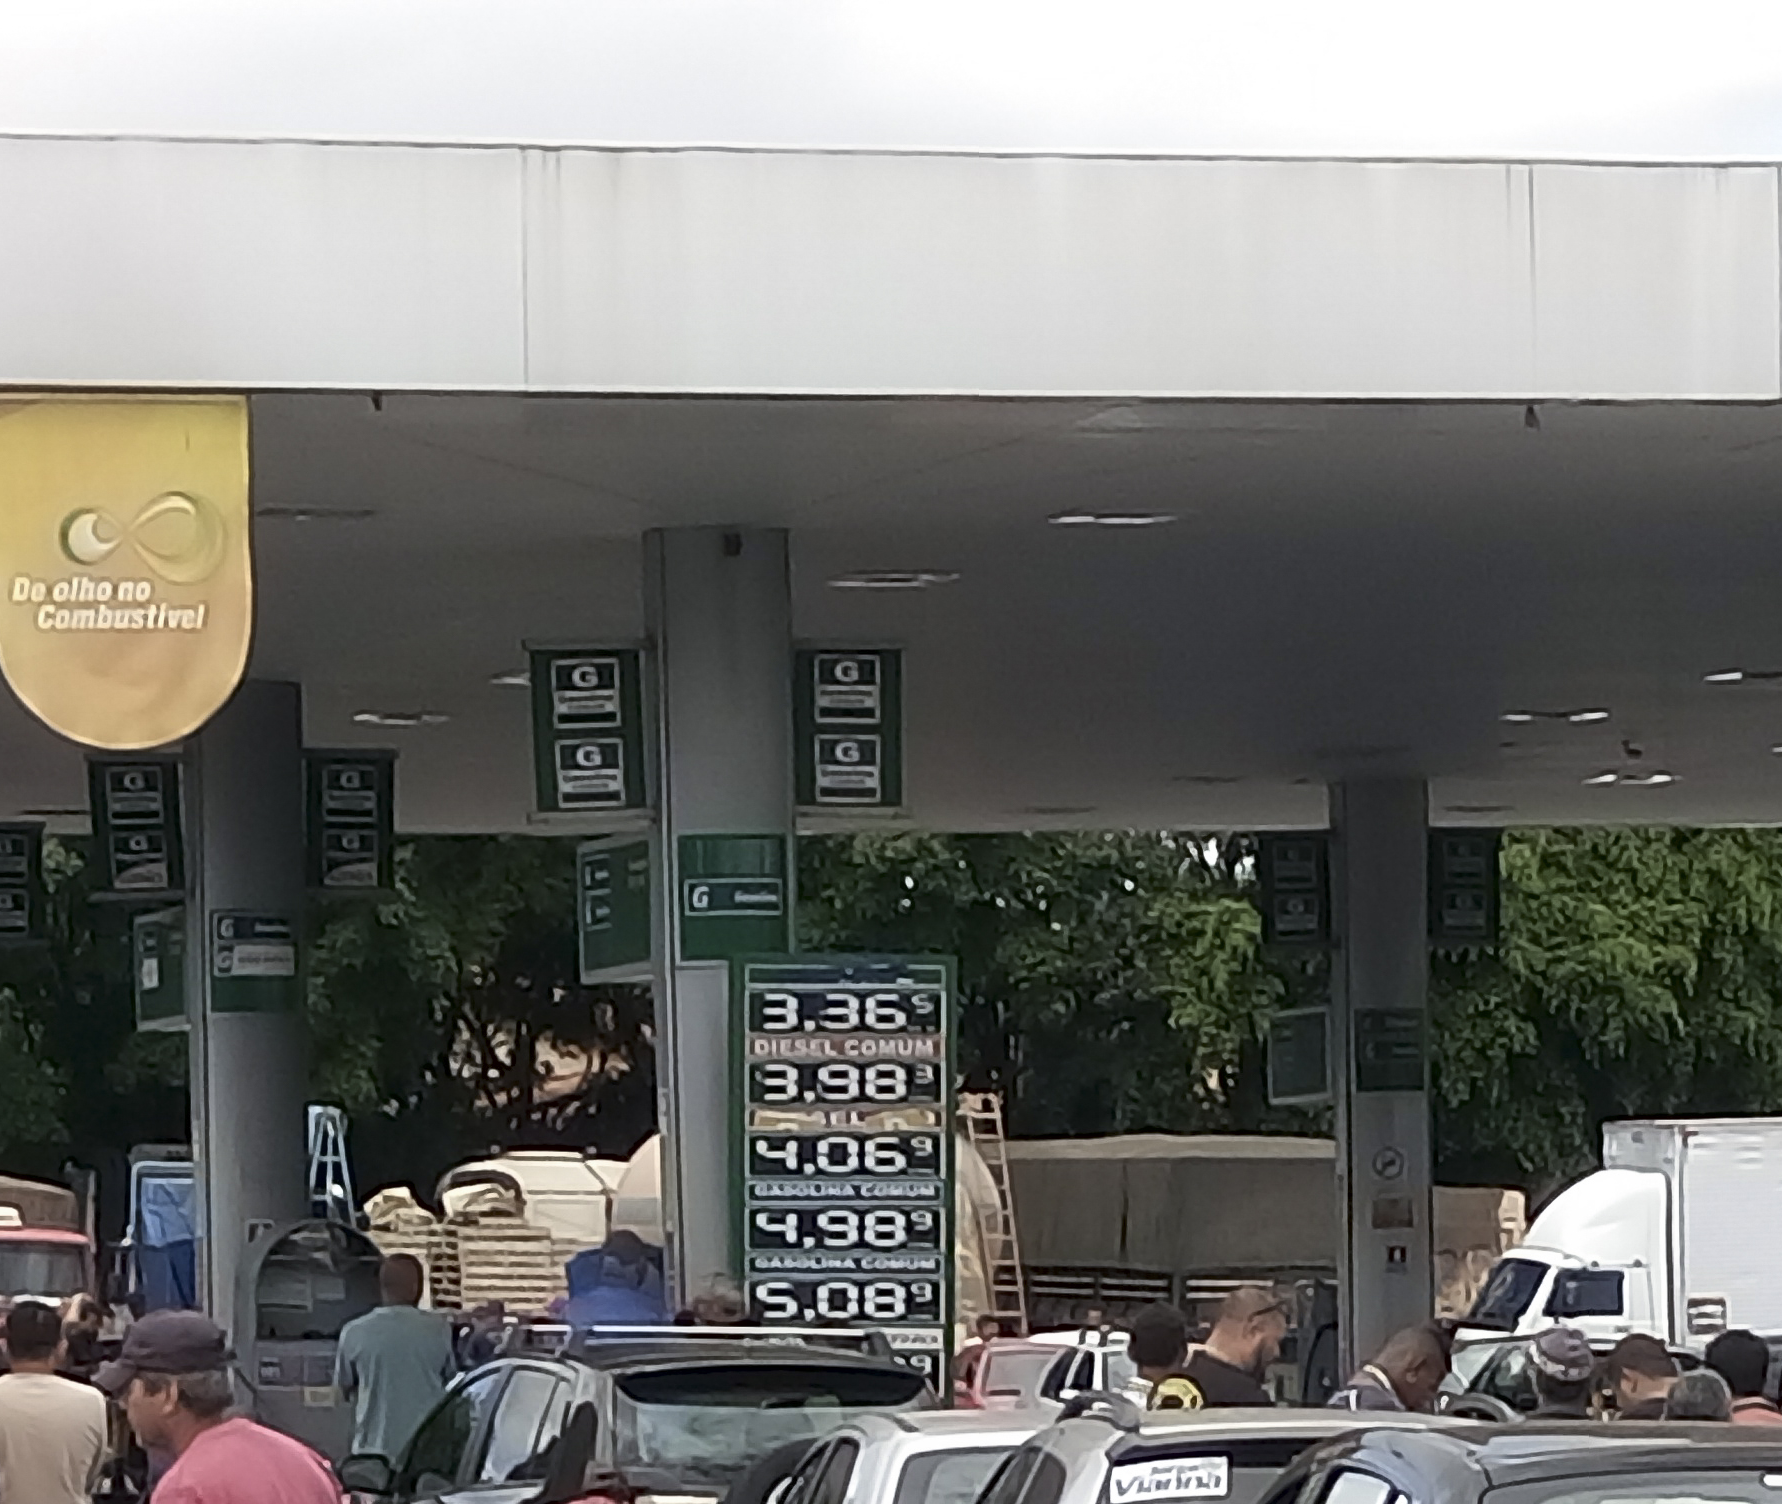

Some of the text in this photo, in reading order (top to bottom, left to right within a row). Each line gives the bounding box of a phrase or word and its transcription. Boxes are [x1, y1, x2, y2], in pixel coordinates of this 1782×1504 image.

[12, 576, 152, 602] De olho no
[754, 1039, 934, 1057] DIESEL COMUM
